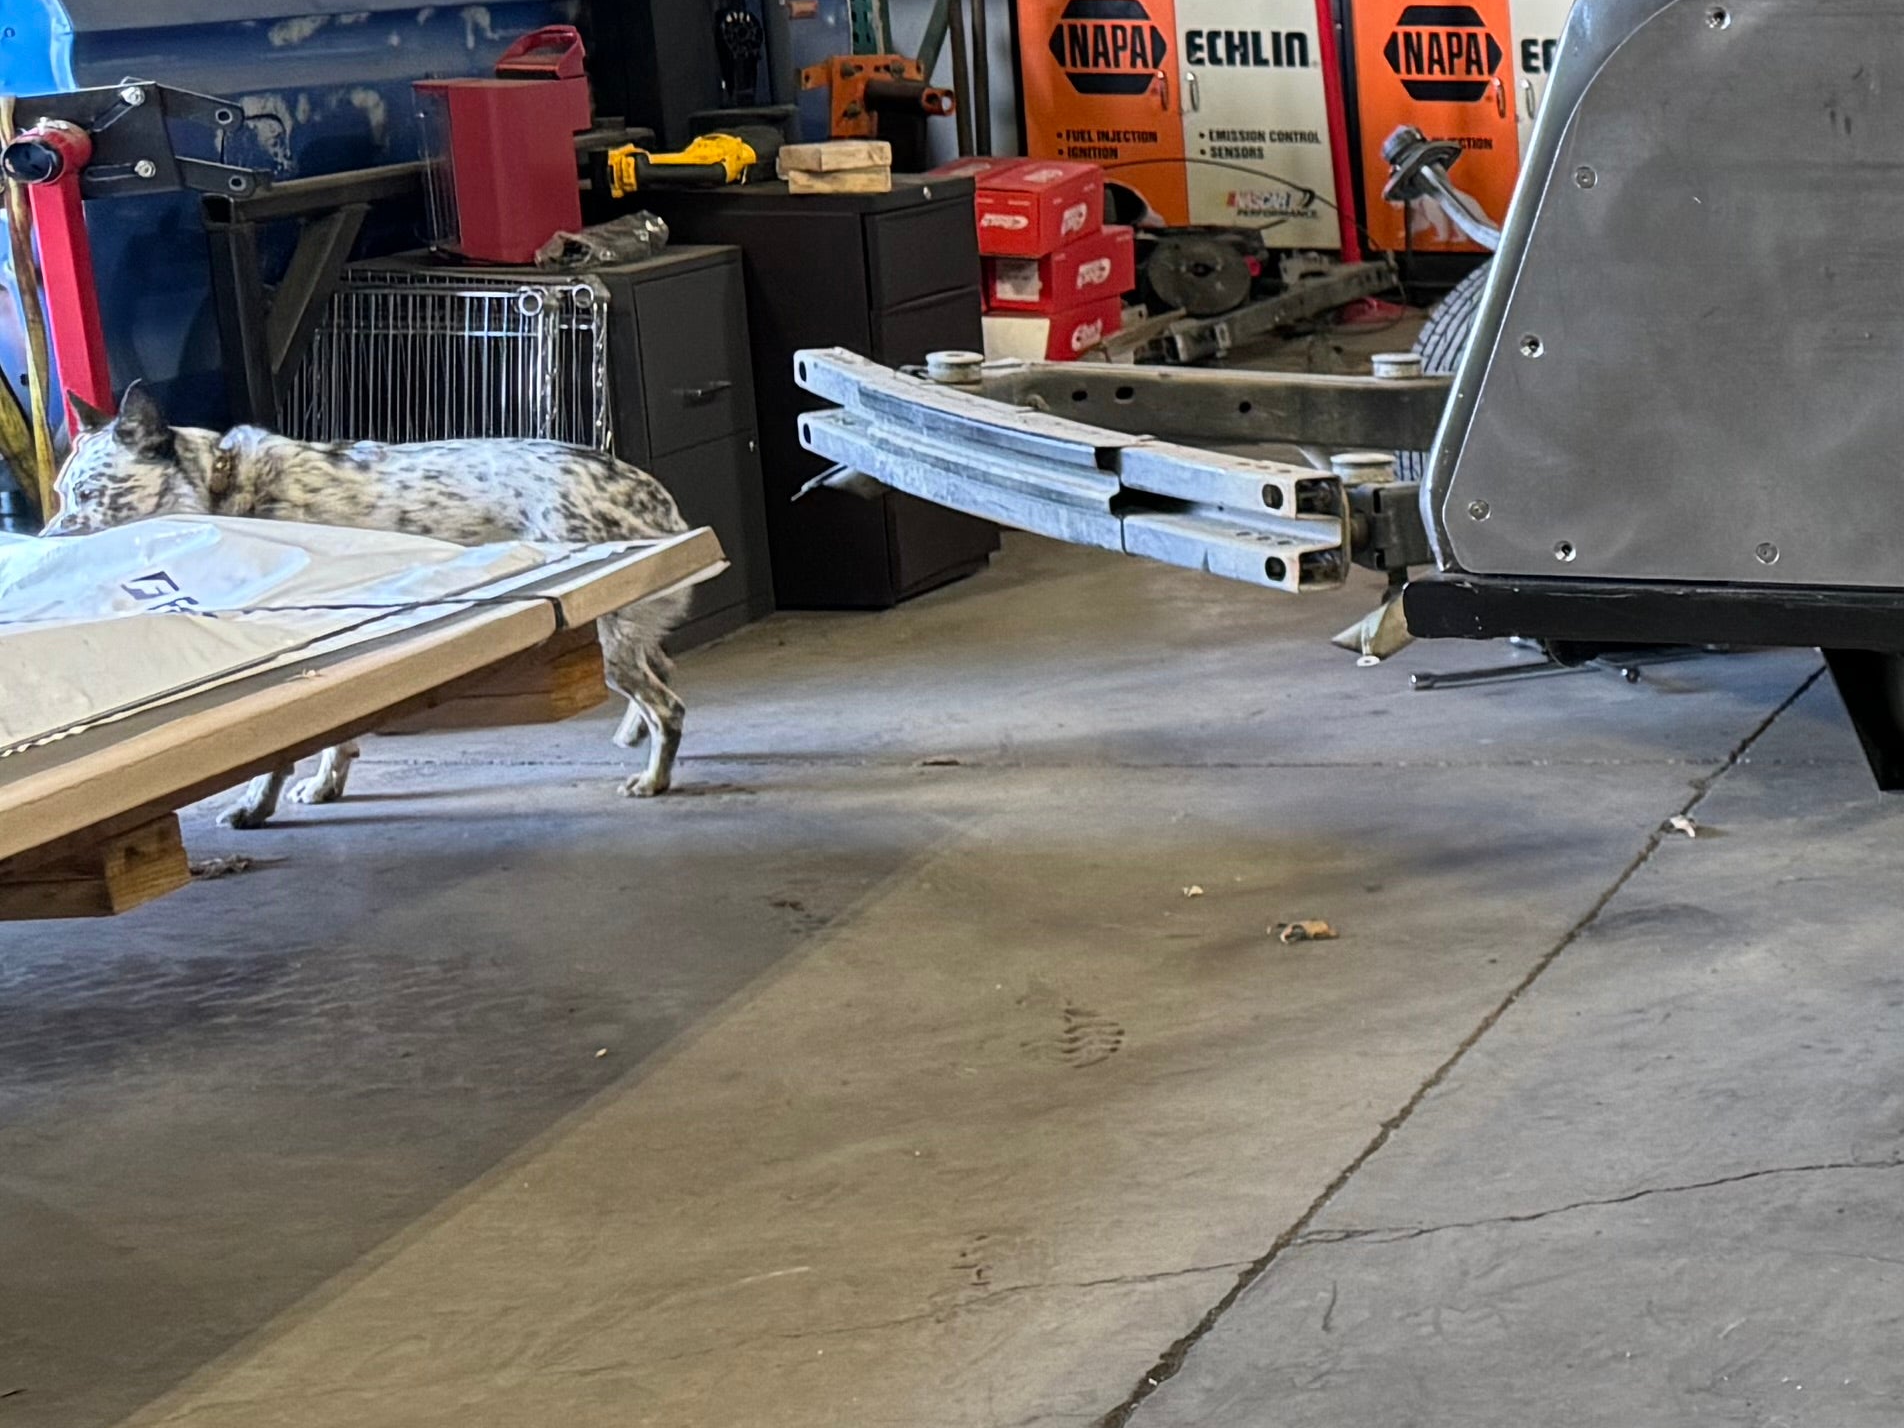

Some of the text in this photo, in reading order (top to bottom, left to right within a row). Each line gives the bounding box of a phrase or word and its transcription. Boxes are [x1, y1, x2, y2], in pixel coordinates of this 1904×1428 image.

[1068, 24, 1149, 69] NAPA
[1185, 30, 1309, 68] ECHLIN
[1402, 31, 1485, 76] NAPA
[1065, 129, 1158, 143] FUEL INJECTION
[1208, 129, 1322, 144] EMISSION CONTROL
[1067, 146, 1119, 160] IGNITION
[1210, 146, 1264, 160] SENSORS
